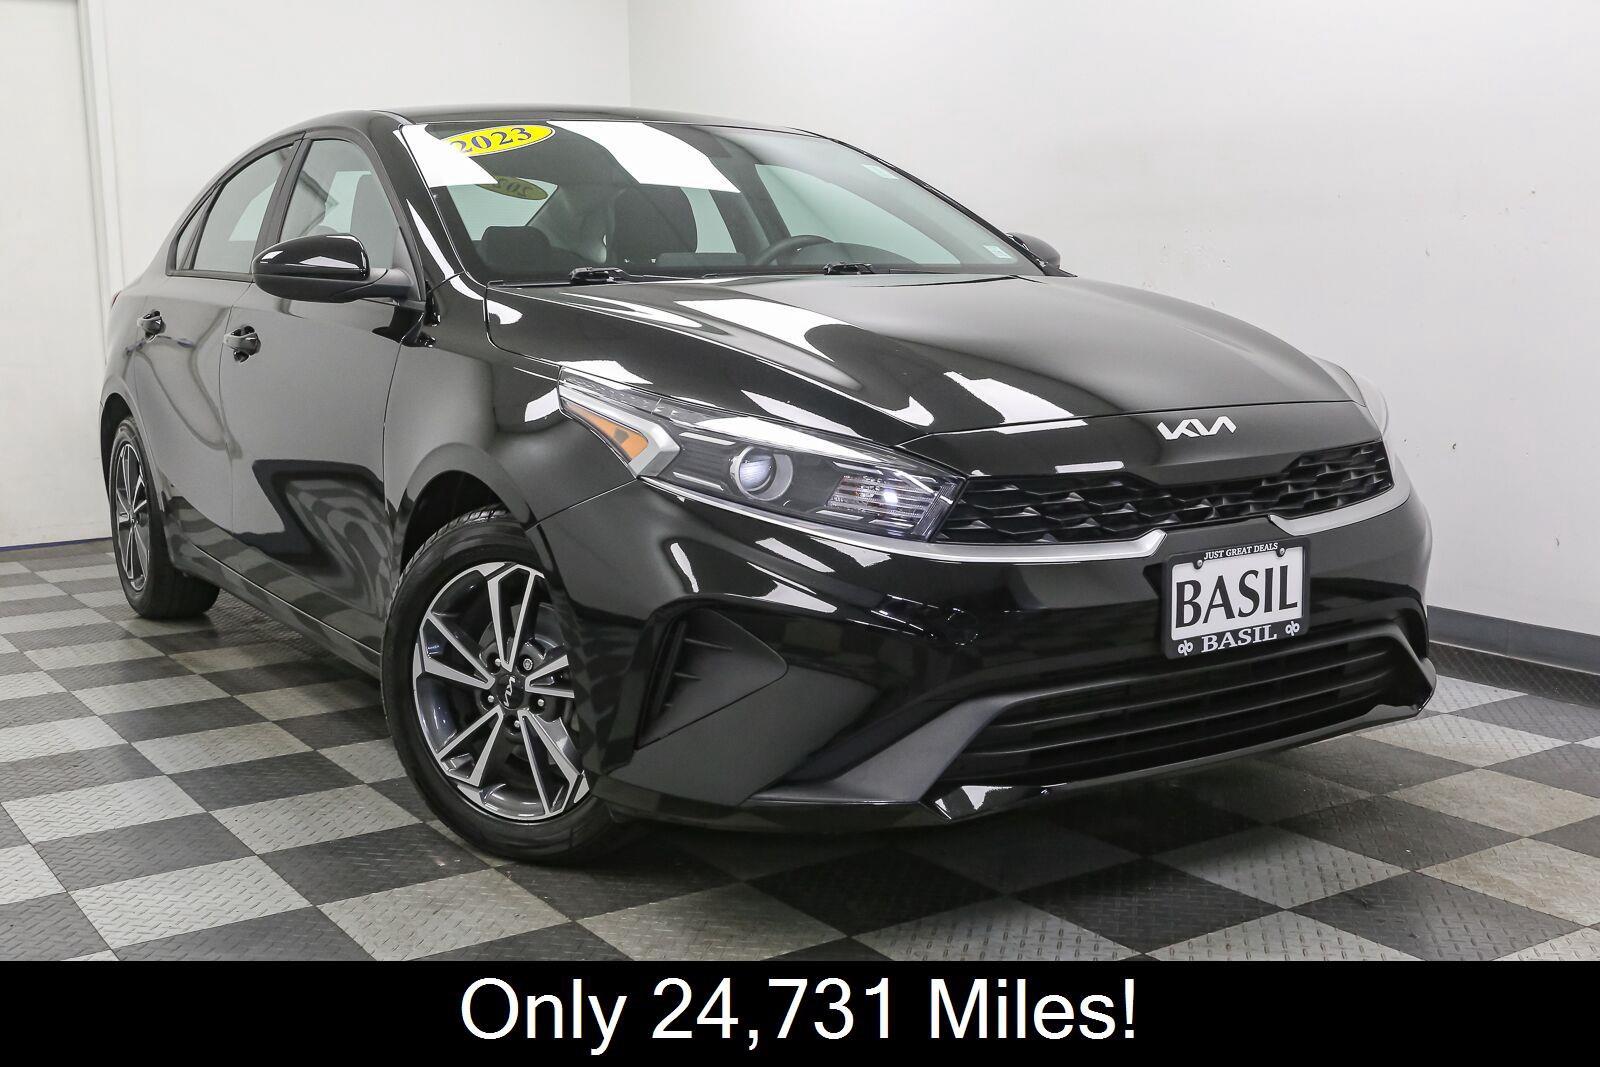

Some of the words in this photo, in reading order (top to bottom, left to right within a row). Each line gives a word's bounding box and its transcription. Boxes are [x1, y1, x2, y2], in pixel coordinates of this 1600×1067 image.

[450, 127, 532, 153] 2023
[1157, 416, 1237, 440] KIA
[1203, 550, 1225, 560] JUST
[1225, 546, 1253, 557] GREAT
[1253, 542, 1279, 553] DEALS
[1175, 565, 1298, 628] BASIL
[1201, 625, 1278, 653] BASIL
